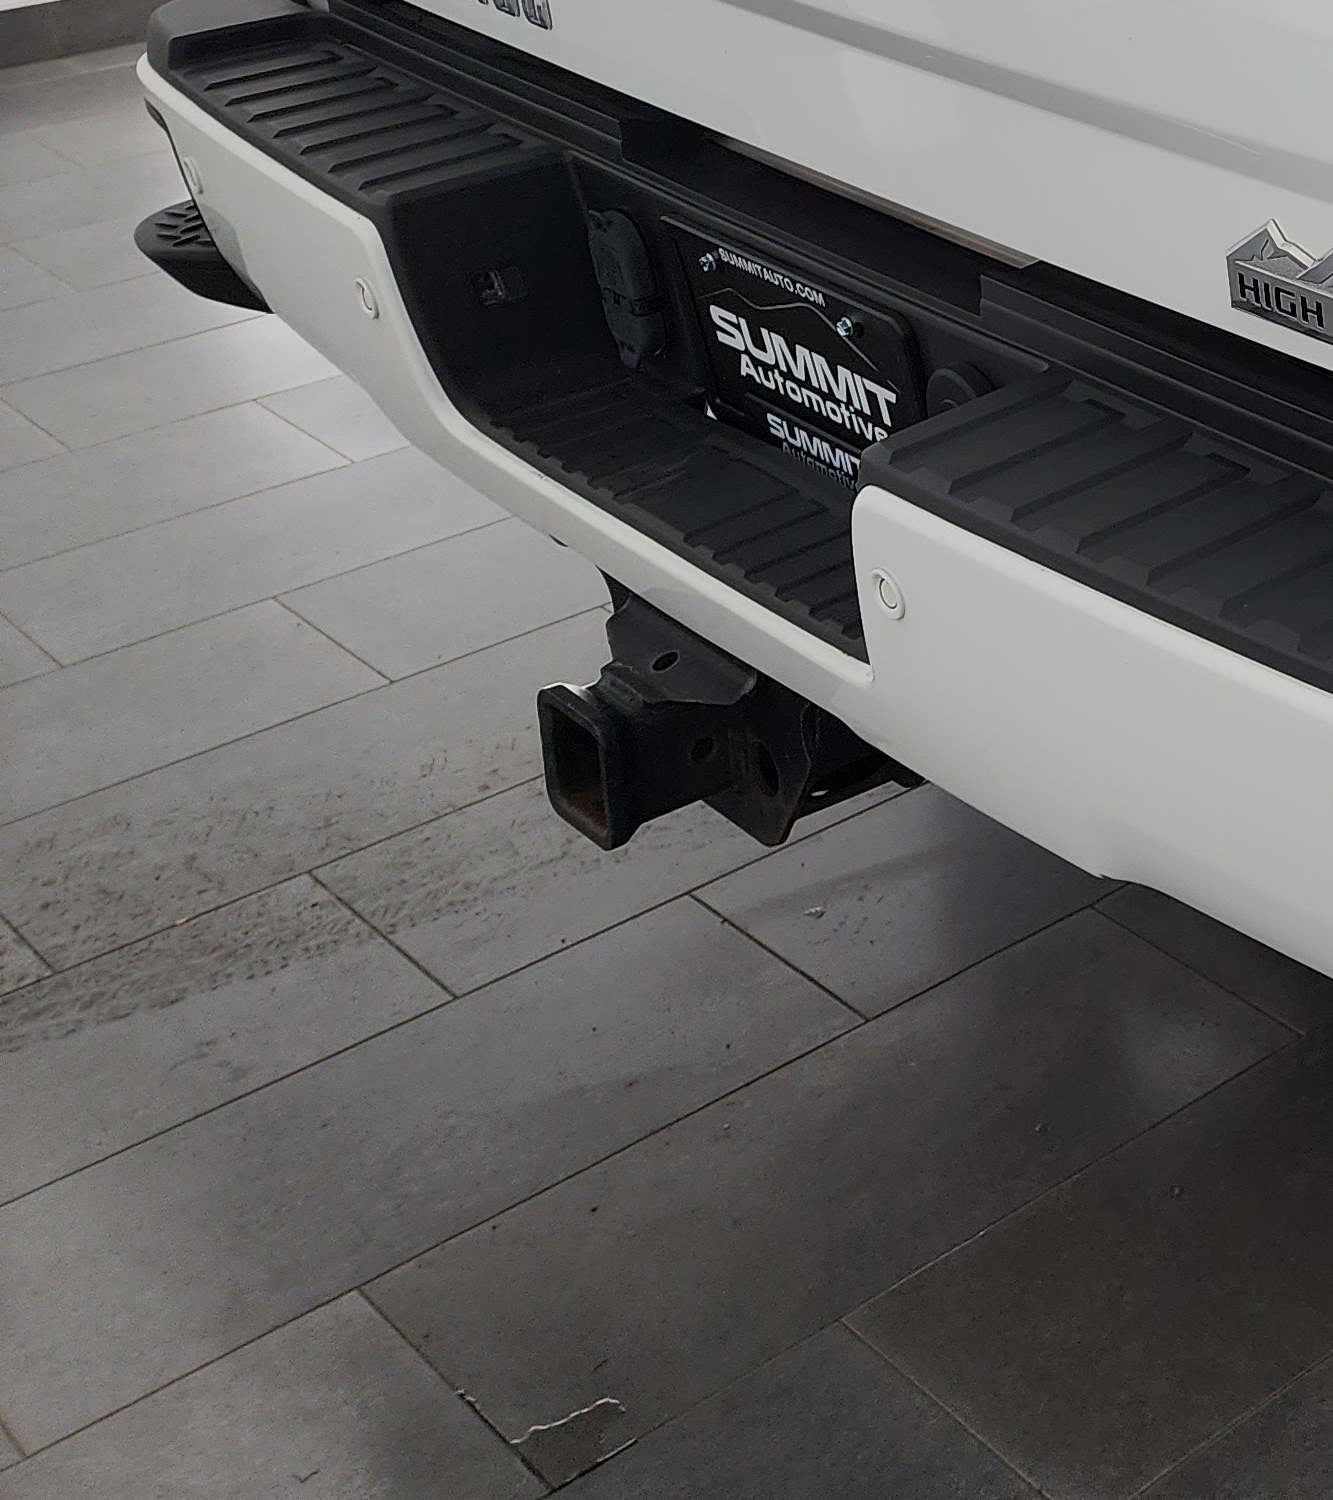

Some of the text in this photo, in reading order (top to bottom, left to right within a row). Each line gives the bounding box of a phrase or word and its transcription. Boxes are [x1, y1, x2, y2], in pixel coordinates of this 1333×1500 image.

[718, 247, 826, 307] SUMMITAUTO.COM
[1237, 272, 1326, 330] HIGH
[709, 304, 897, 427] SUMMIT
[740, 353, 888, 442] Automotive
